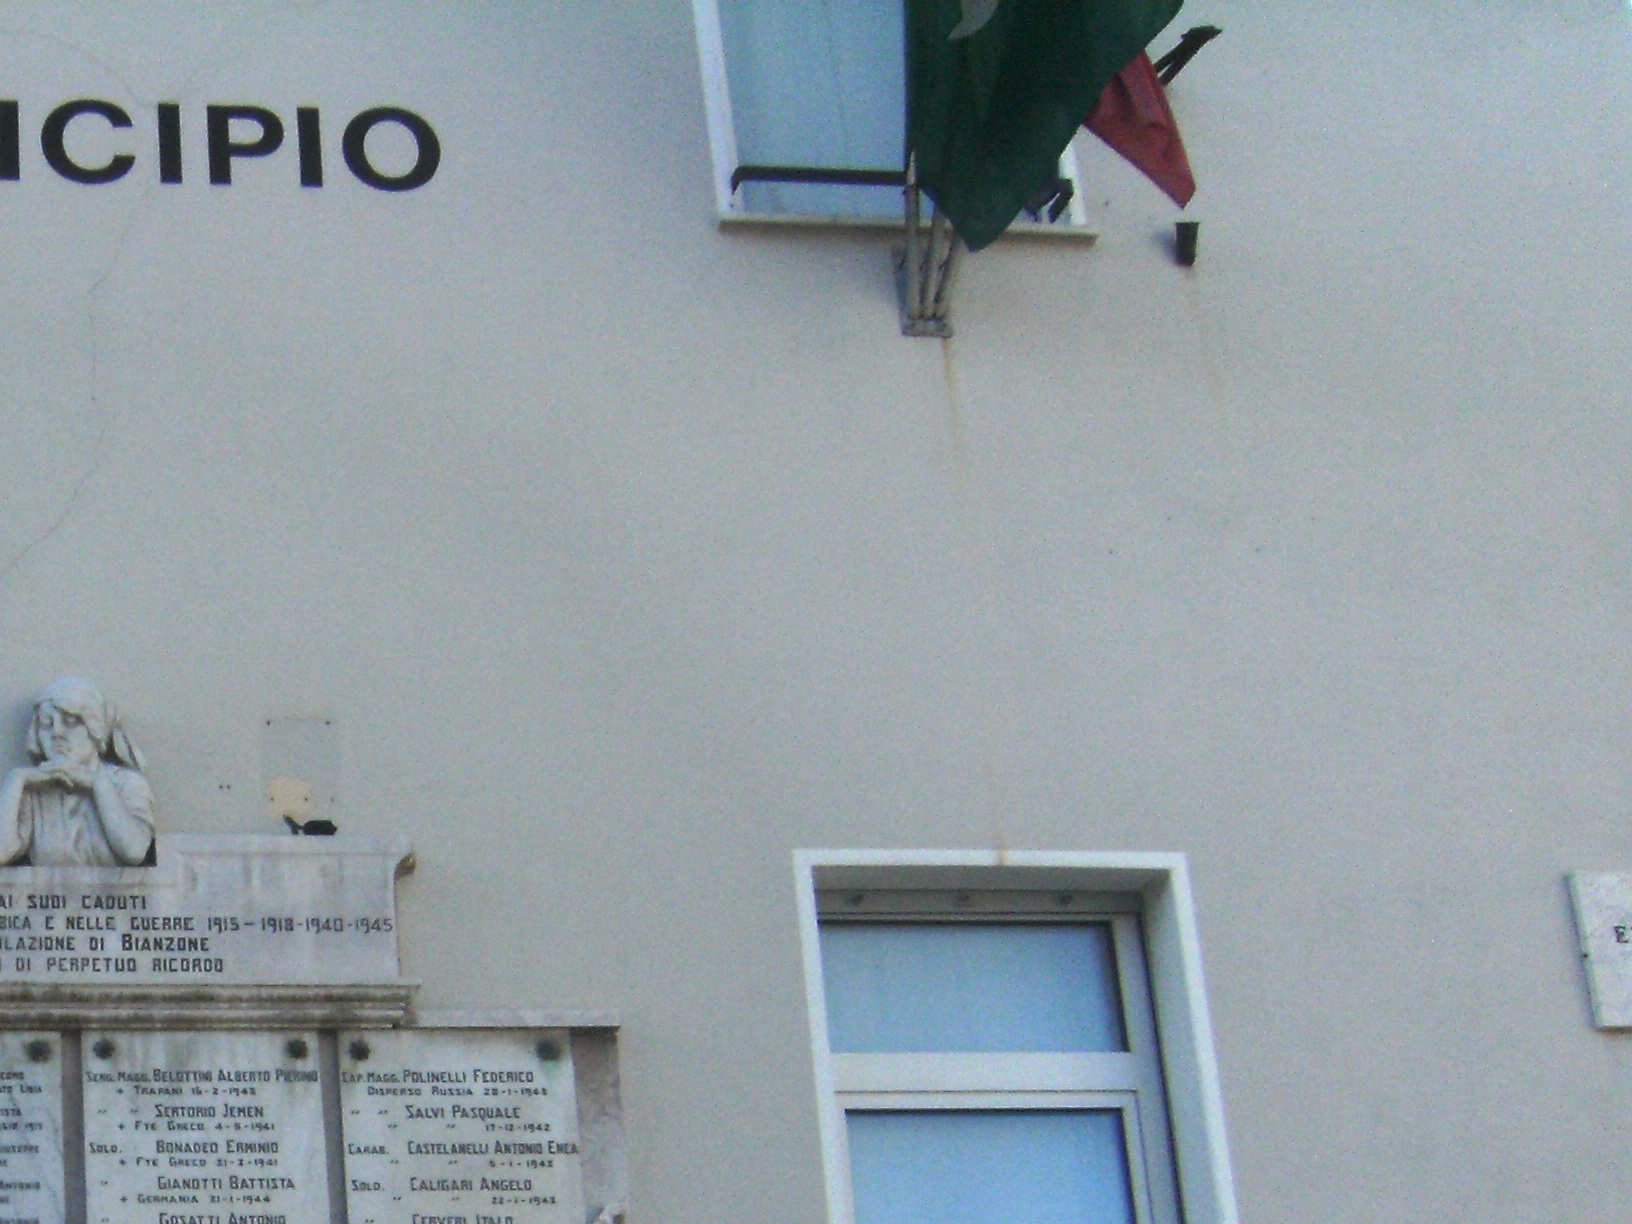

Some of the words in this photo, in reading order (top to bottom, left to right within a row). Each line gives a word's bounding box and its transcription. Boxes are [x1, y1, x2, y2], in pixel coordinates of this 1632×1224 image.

[82, 895, 146, 909] CADUTI
[45, 916, 54, 930] E
[66, 916, 115, 930] NELLE
[130, 916, 194, 931] GUERRE
[90, 937, 104, 951] DI
[16, 958, 31, 972] DI
[47, 958, 137, 972] PERPETUO
[153, 958, 223, 972] RICORDO
[403, 1070, 466, 1083] POLINELLI
[473, 1069, 533, 1083] FEDERICO
[405, 1105, 444, 1118] SALVI
[452, 1105, 519, 1119] PASQUALE
[480, 1178, 532, 1191] ANGELO
